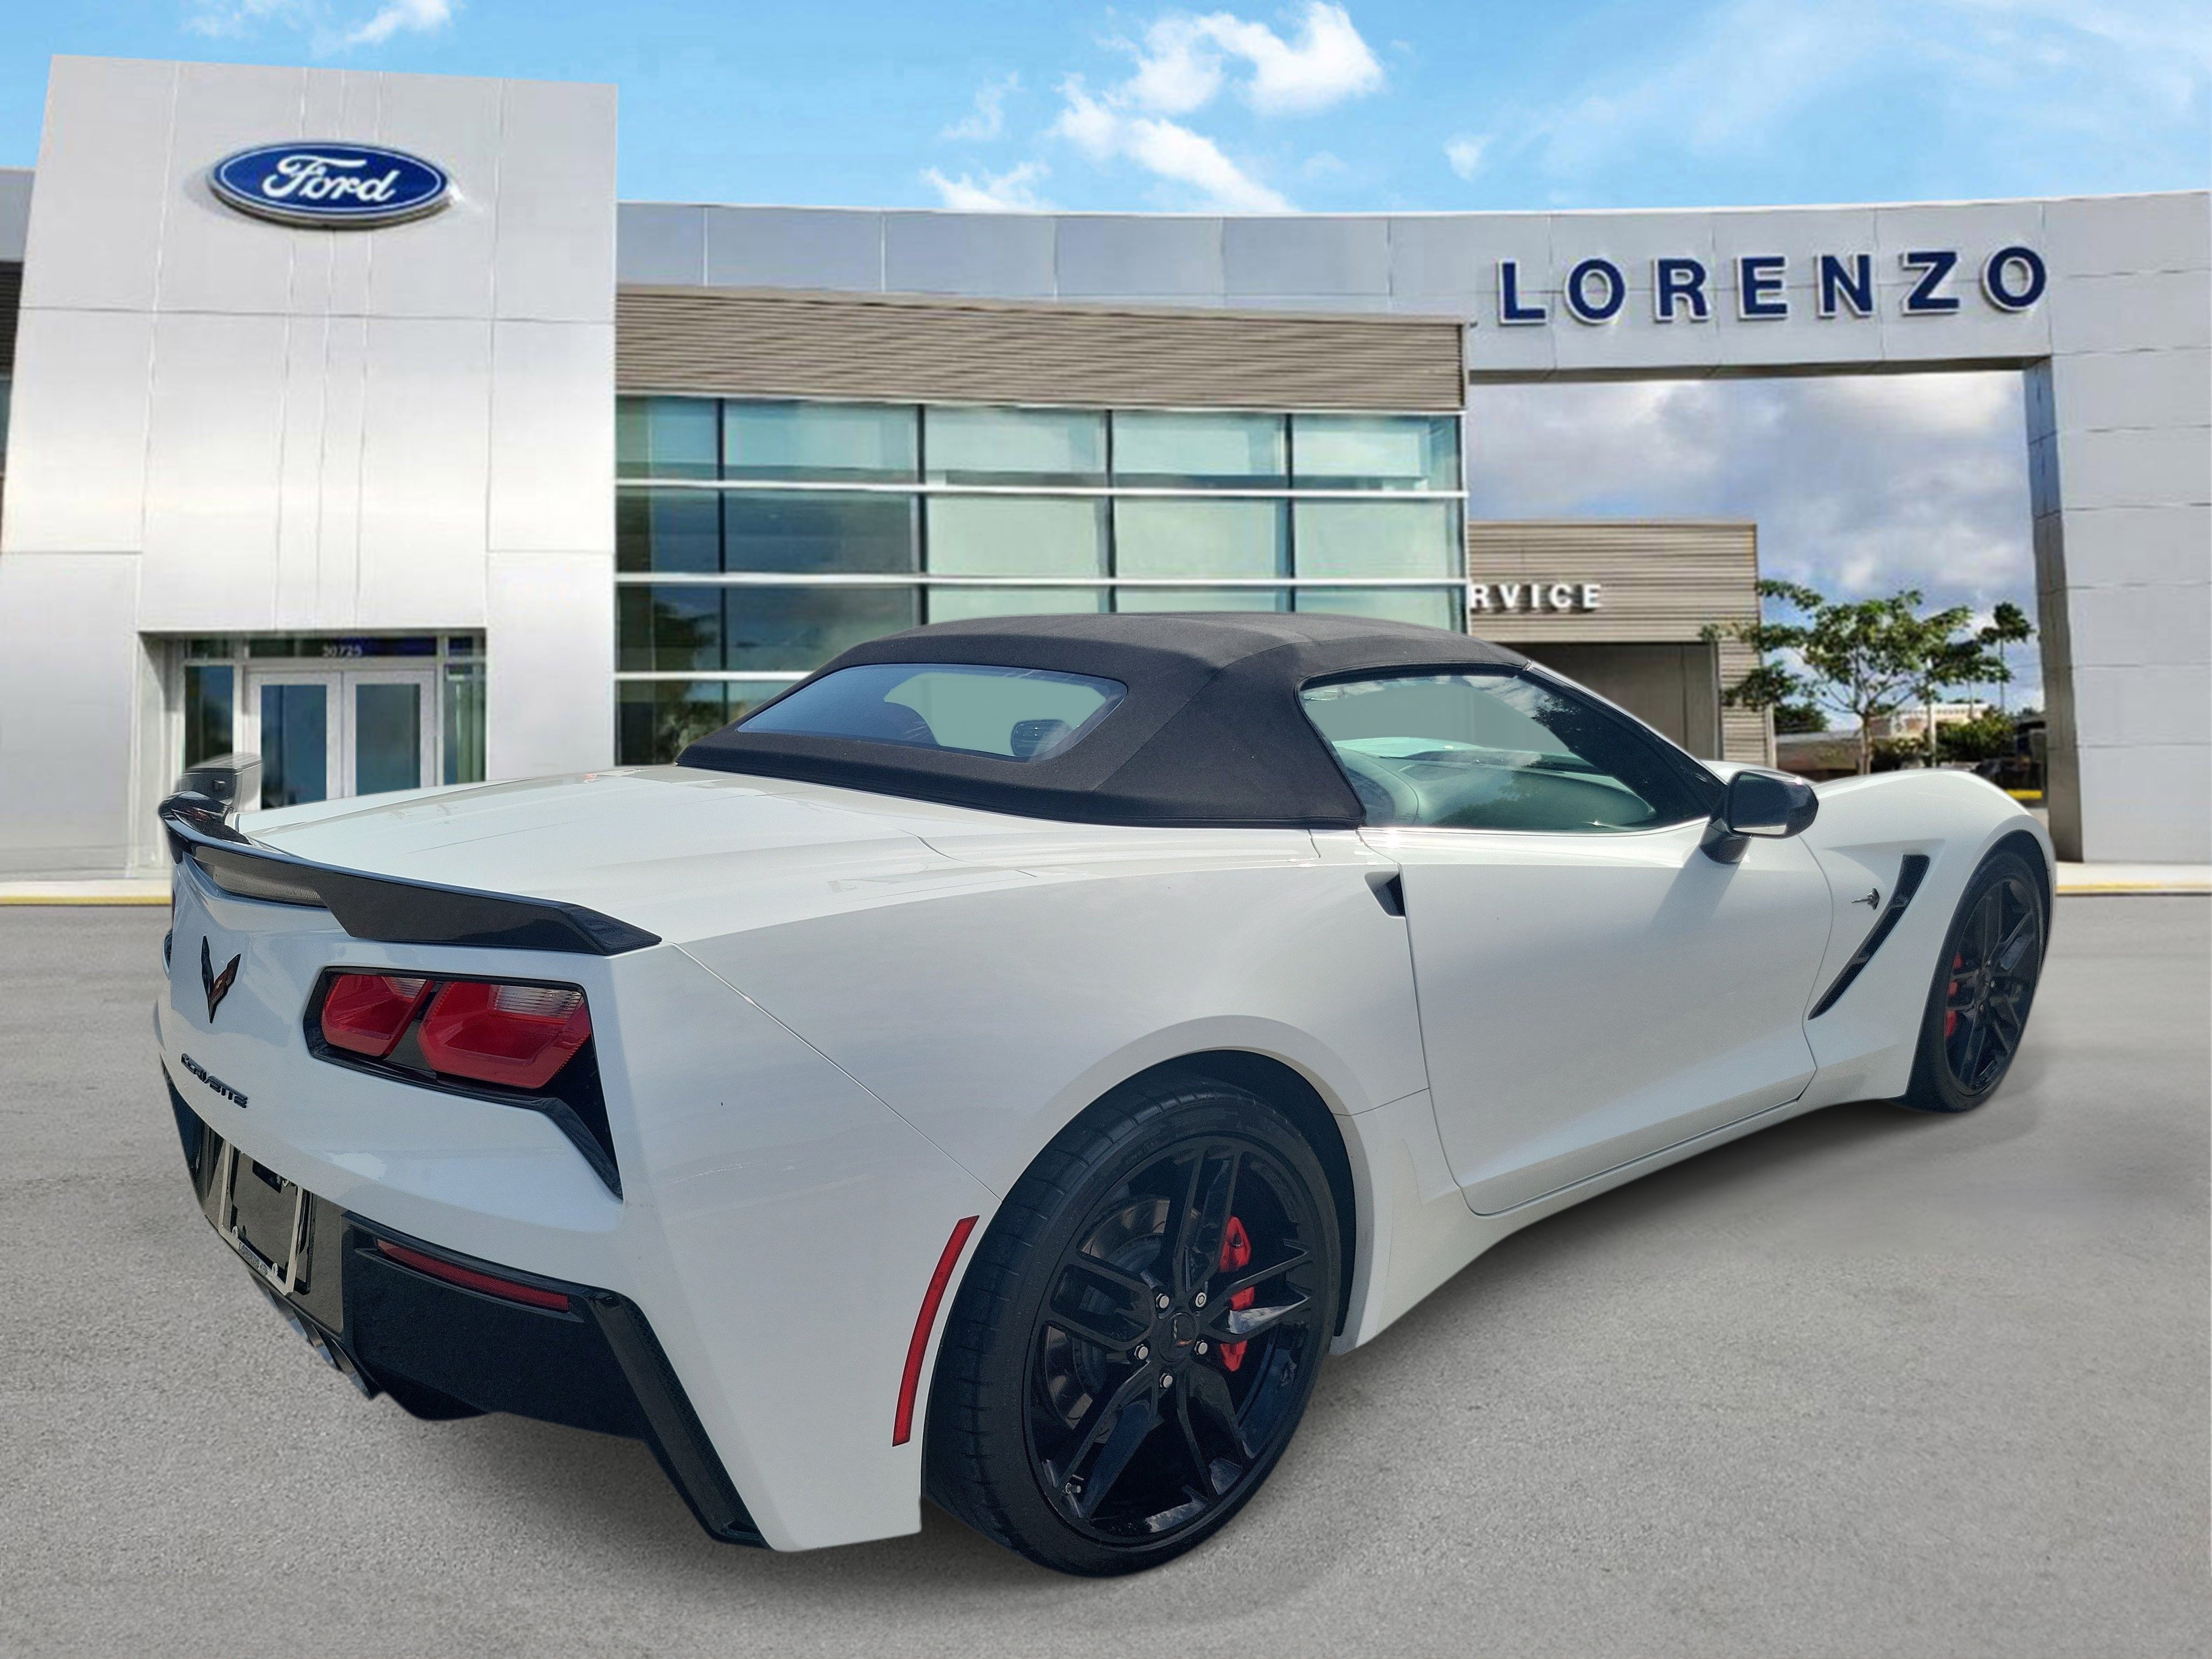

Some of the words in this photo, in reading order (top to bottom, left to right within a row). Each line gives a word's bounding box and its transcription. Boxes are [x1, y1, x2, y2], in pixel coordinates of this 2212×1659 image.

[263, 154, 401, 202] Ford
[1496, 246, 2048, 324] LORENZO
[181, 1053, 248, 1109] CORVETTE
